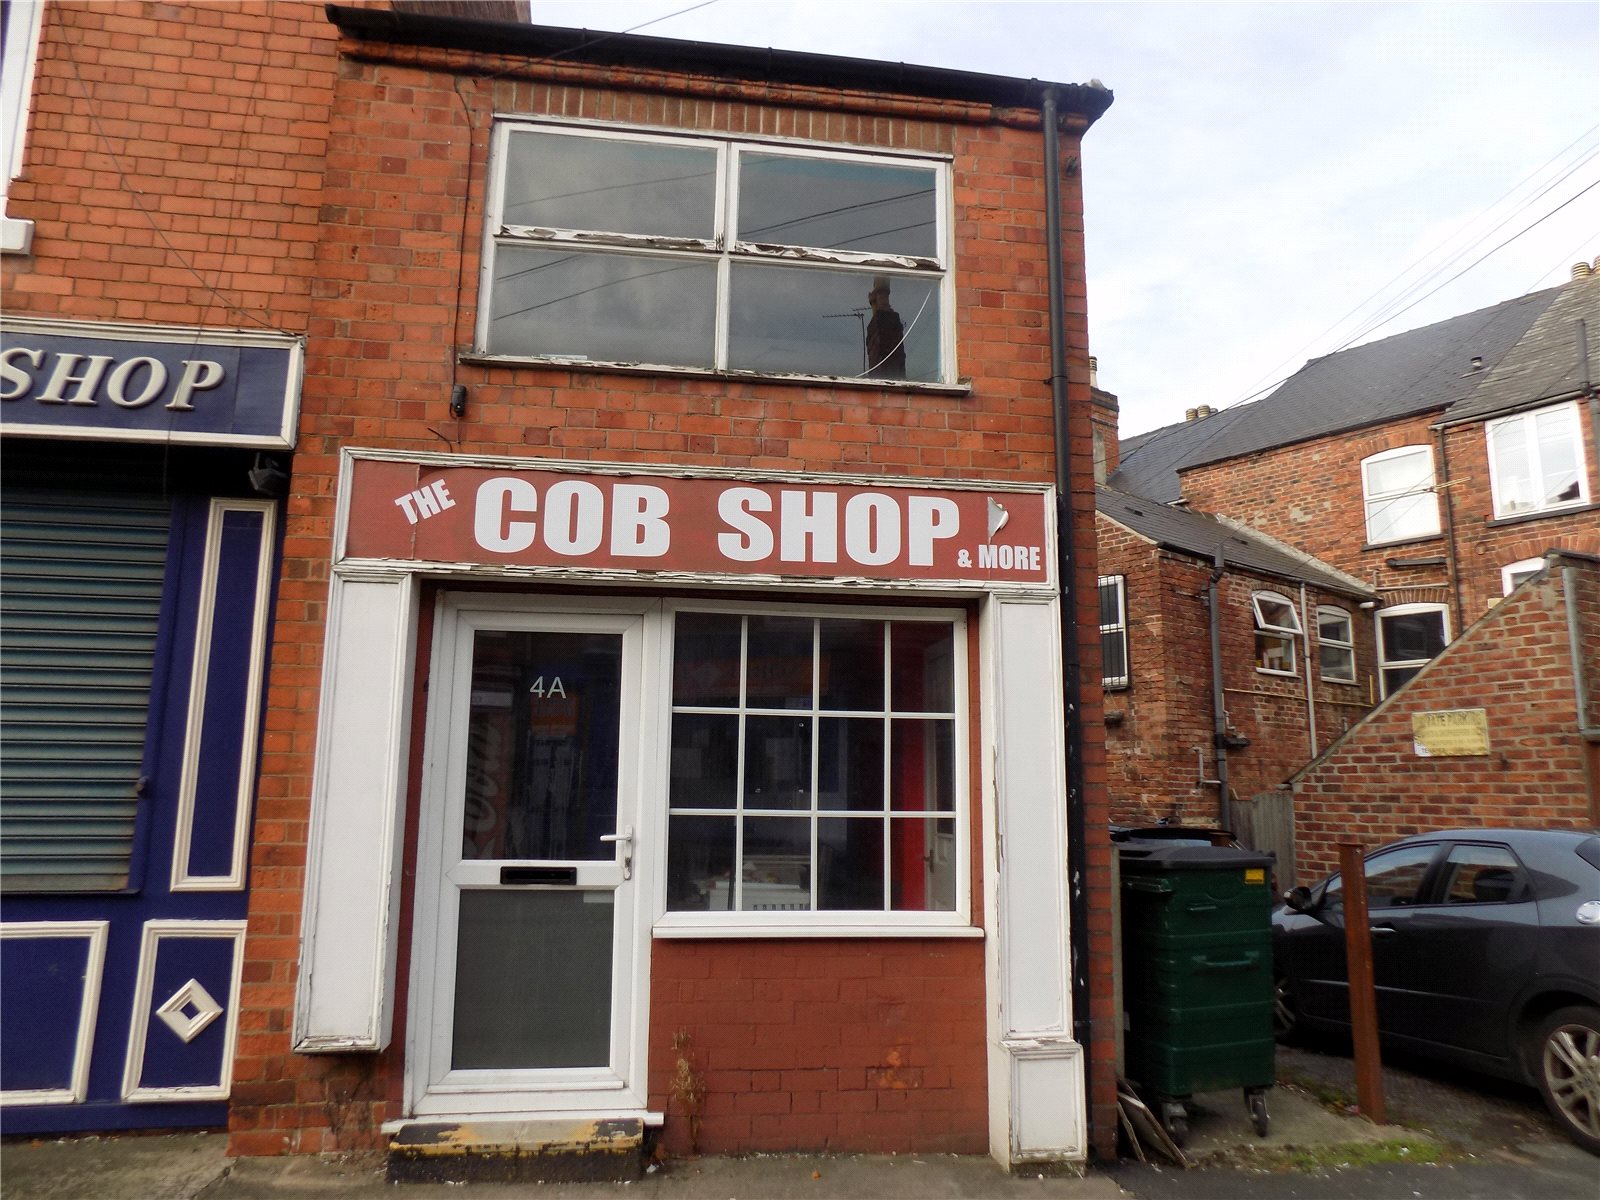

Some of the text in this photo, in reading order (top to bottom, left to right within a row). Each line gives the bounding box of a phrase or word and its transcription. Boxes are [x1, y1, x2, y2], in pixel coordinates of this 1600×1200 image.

[0, 347, 226, 411] SHOP
[394, 477, 960, 567] THE COB SHOP
[957, 544, 1041, 571] & MORE
[529, 675, 567, 699] 4A
